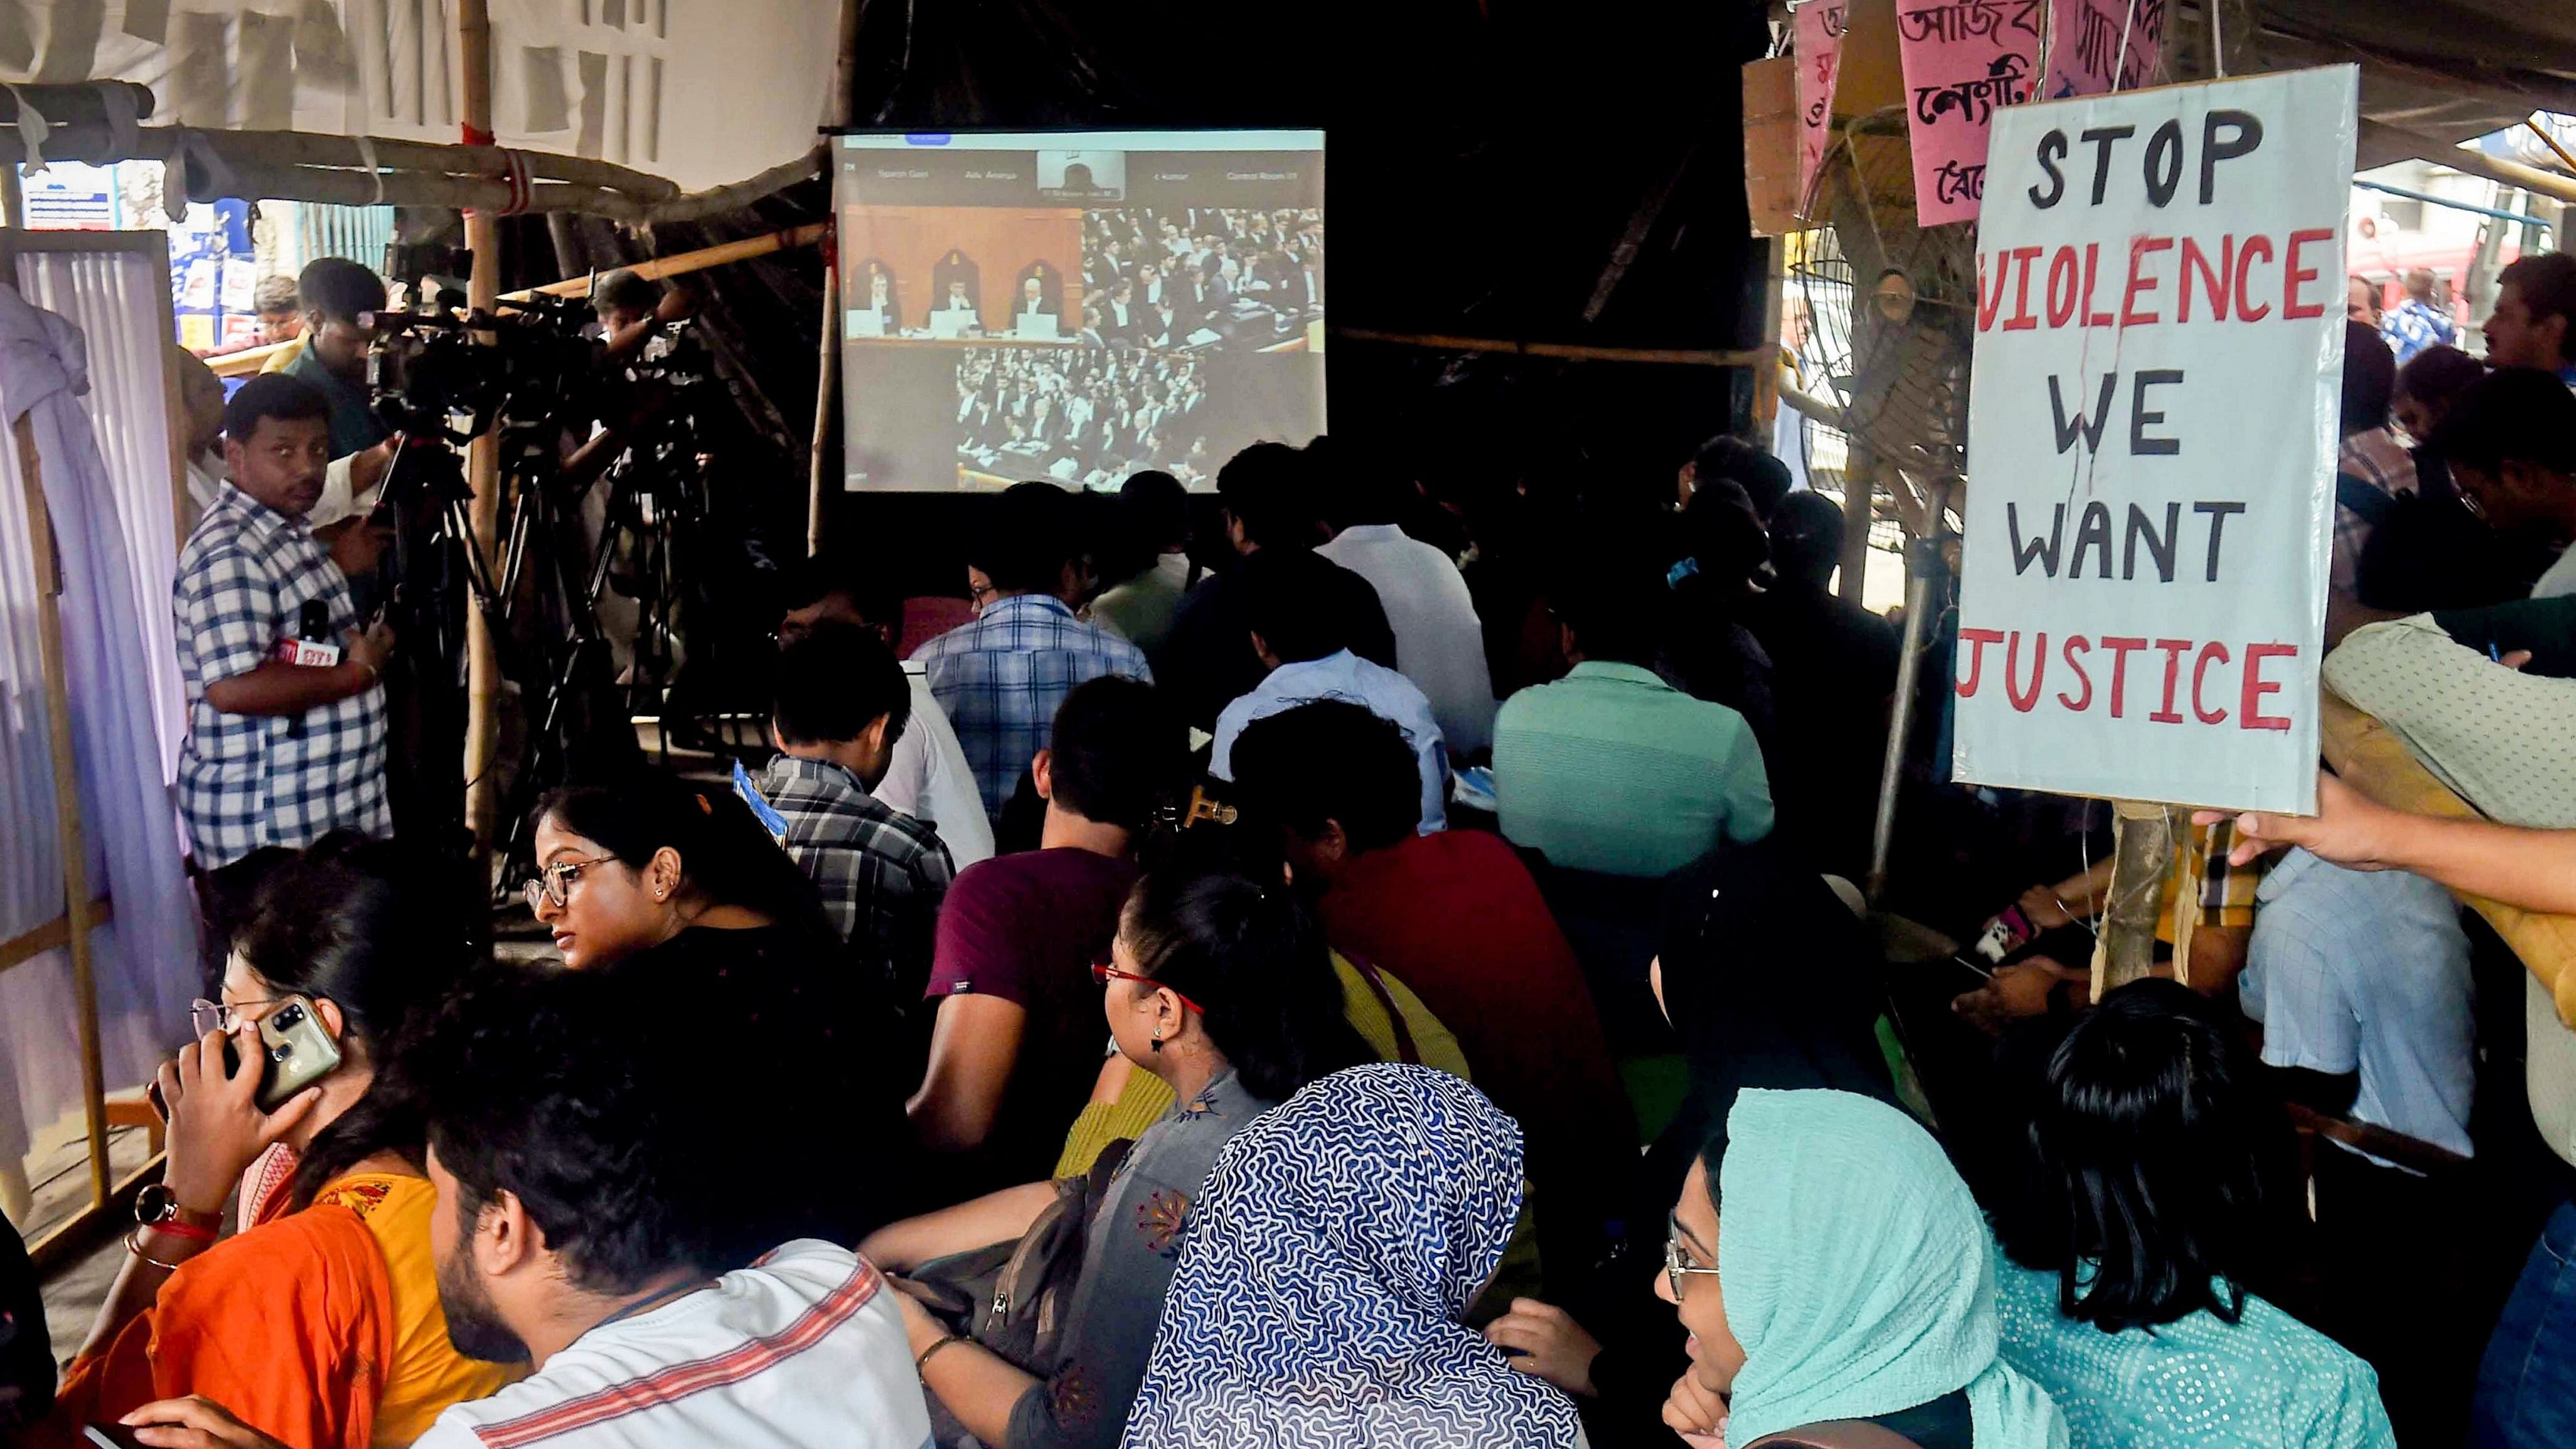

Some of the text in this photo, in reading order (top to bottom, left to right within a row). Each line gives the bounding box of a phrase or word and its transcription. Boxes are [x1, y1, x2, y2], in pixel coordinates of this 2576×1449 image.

[2028, 109, 2264, 209] STOP
[1978, 228, 2334, 333] VIOLENCE
[2048, 370, 2184, 454] WE
[2007, 501, 2245, 582] WANT
[1955, 628, 2297, 733] JUSTICE
